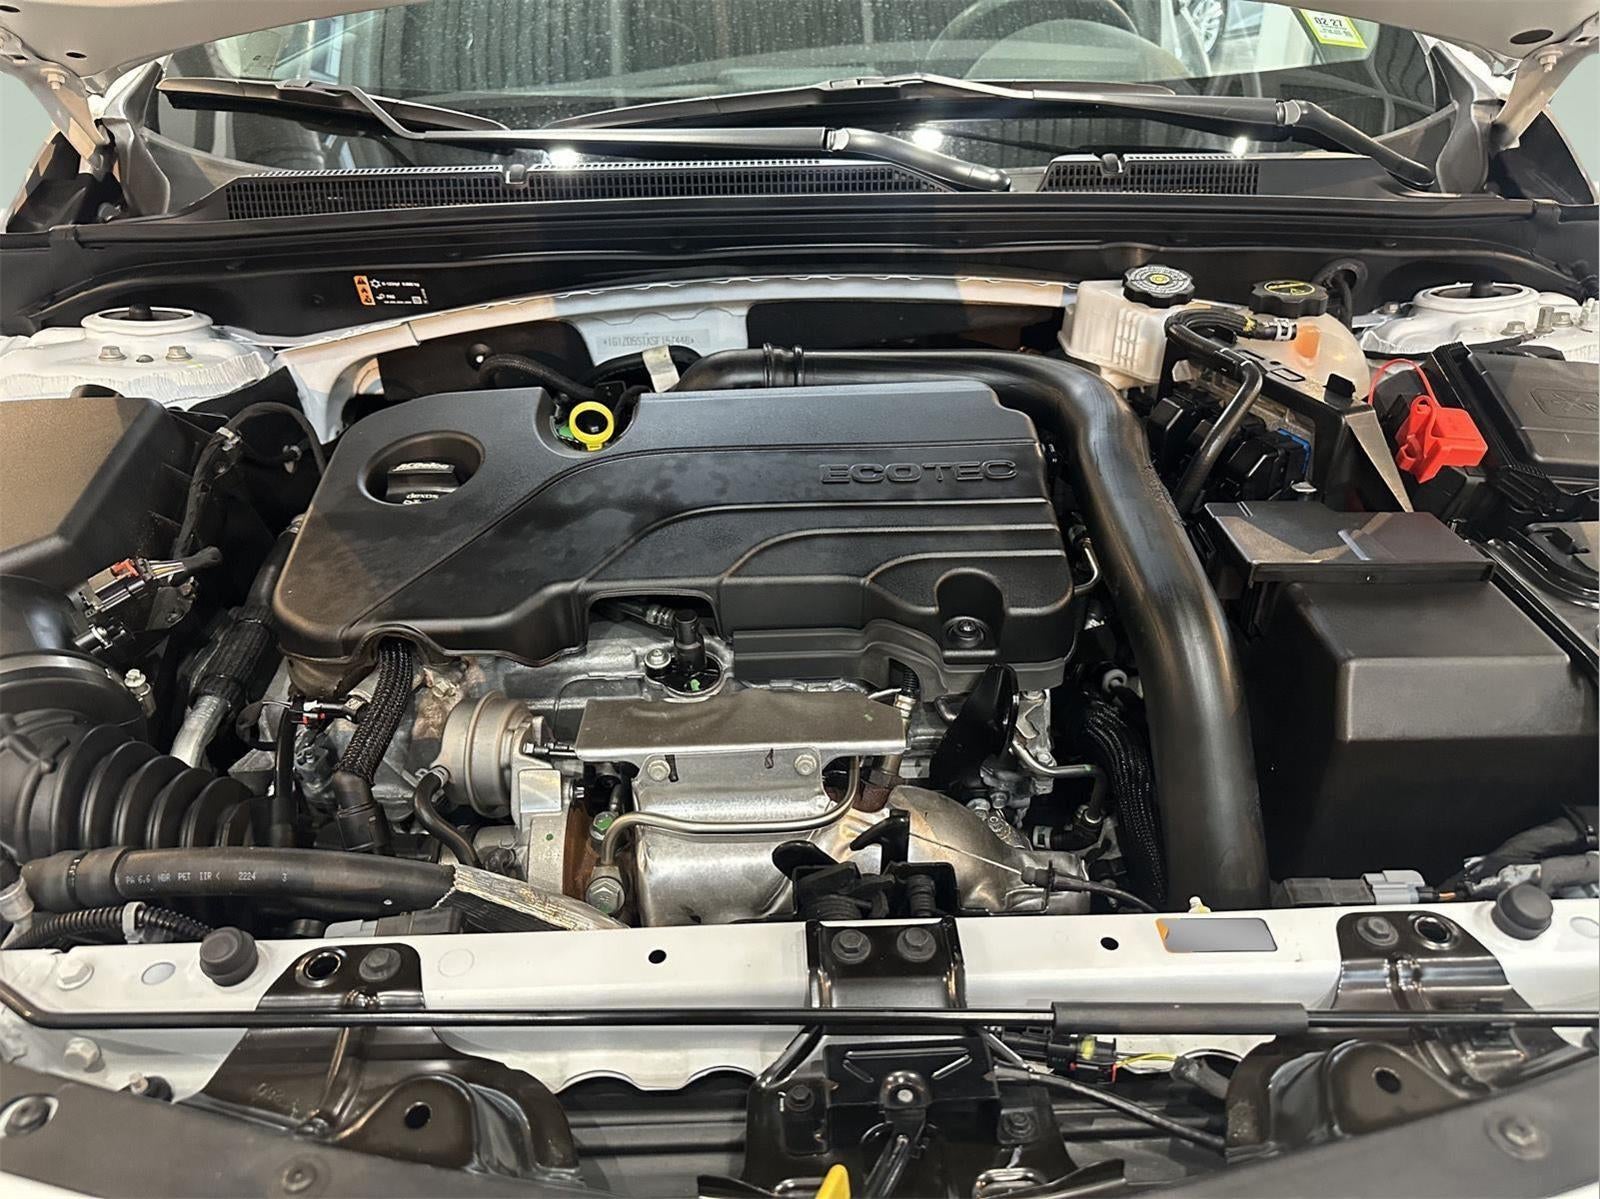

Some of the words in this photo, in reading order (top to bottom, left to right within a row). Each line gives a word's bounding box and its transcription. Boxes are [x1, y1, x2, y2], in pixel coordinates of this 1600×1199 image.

[819, 460, 1016, 484] ECOTEC
[178, 872, 191, 882] PET
[239, 871, 256, 881] 2224
